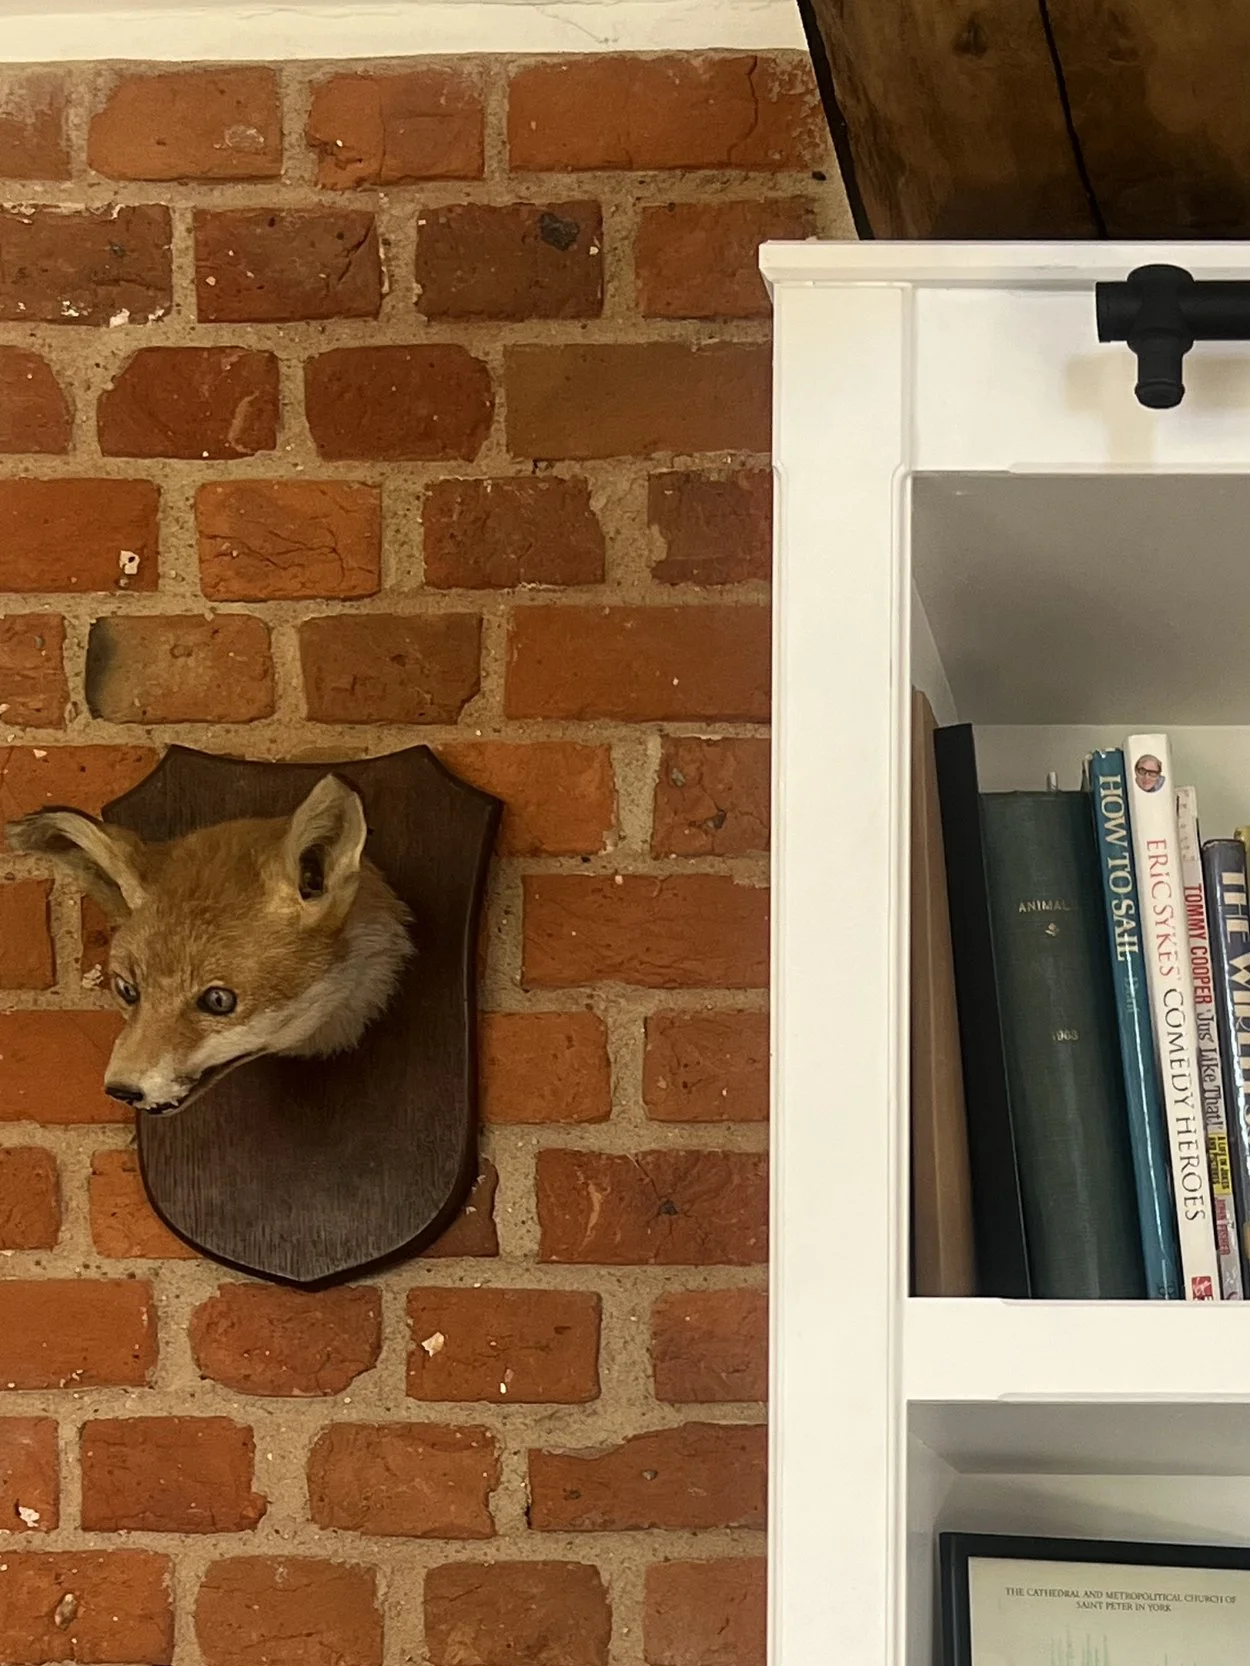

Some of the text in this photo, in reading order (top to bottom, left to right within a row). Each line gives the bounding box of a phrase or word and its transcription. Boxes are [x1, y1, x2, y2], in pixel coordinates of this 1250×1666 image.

[1099, 774, 1140, 962] HOW TO SAIL
[1183, 883, 1206, 942] TOMMY
[1221, 872, 1250, 943] THE
[1152, 902, 1182, 982] SYKES'
[1190, 945, 1213, 1005] COOPER
[1163, 988, 1195, 1112] COMEDY
[1199, 1047, 1219, 1083] Like
[1175, 1115, 1206, 1222] HEROES
[1006, 1587, 1025, 1597] THE
[1026, 1588, 1080, 1599] CATHEDRAL
[1083, 1589, 1103, 1599] AND
[1183, 1594, 1224, 1604] CHURCH
[1225, 1595, 1236, 1604] OF
[1076, 1601, 1172, 1612] SAINT PETER IN YORK
